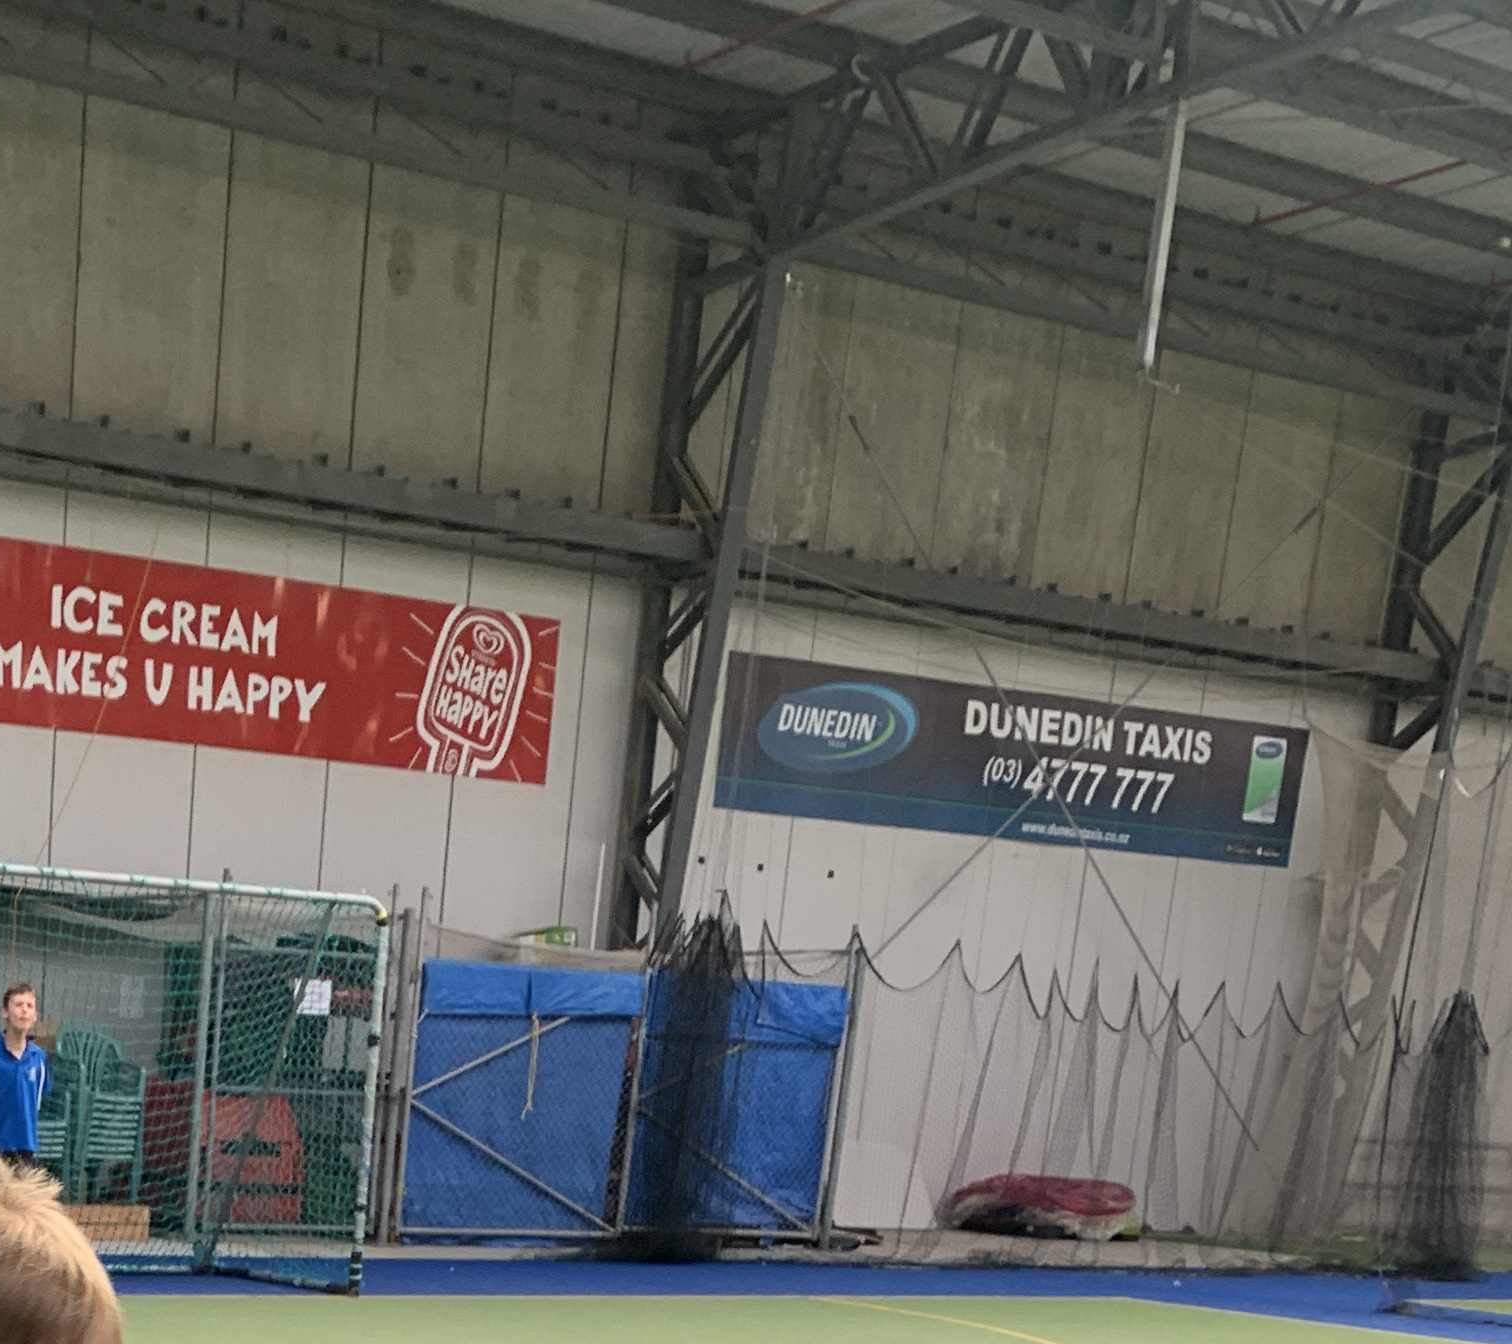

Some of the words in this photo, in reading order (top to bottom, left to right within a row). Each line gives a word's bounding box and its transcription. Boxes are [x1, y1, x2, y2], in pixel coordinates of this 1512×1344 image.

[50, 583, 124, 637] ICE
[139, 597, 278, 658] CREAM
[144, 658, 174, 706] U
[187, 665, 327, 723] HAPPY
[777, 703, 878, 743] DUNEDIN
[964, 699, 1115, 753] DUNEDIN
[1123, 720, 1213, 765] TAXIS
[982, 755, 1023, 790] (03)
[1023, 756, 1108, 806] 4777
[1111, 766, 1176, 814] 777
